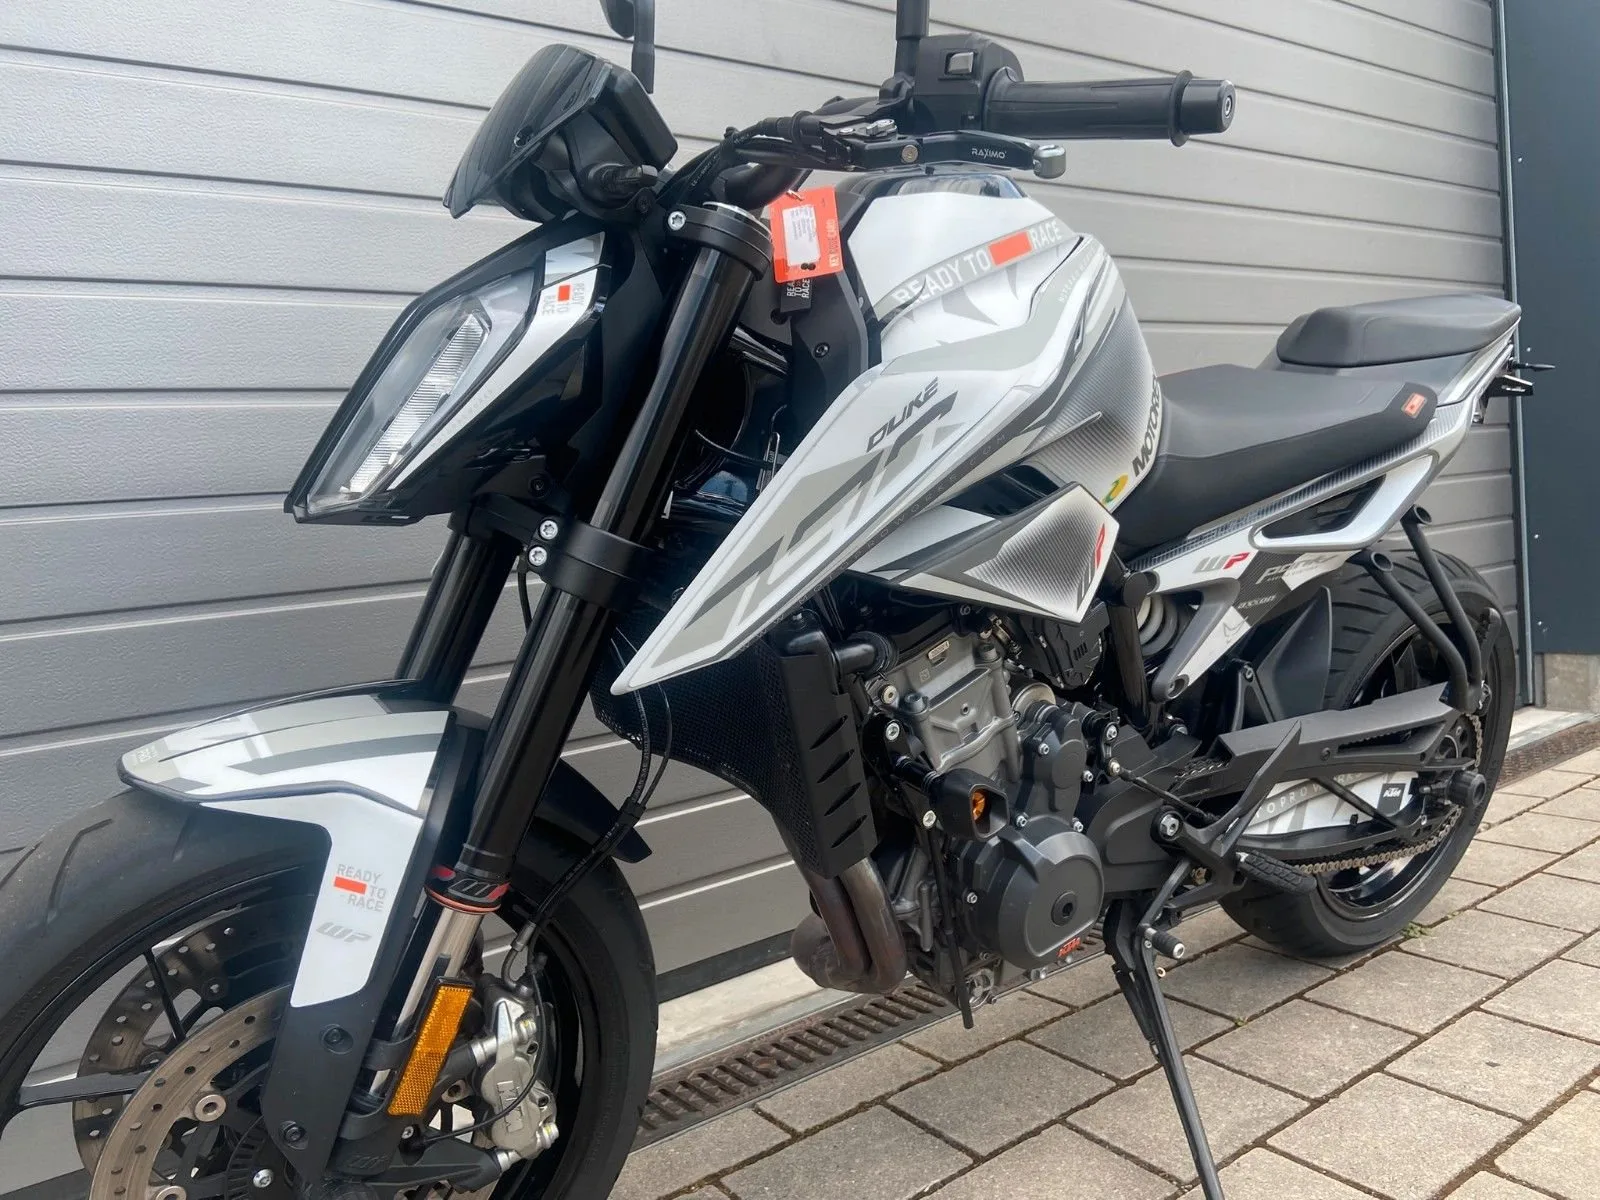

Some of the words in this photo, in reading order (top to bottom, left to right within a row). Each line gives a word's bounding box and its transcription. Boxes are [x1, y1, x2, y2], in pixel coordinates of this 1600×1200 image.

[893, 264, 963, 302] READY
[963, 250, 992, 276] TO
[1029, 220, 1062, 252] RACE
[786, 281, 796, 297] REA
[866, 376, 939, 452] DUKE
[1382, 787, 1402, 798] KTM
[337, 863, 383, 885] READY
[369, 886, 387, 898] TO
[347, 895, 385, 912] RACE
